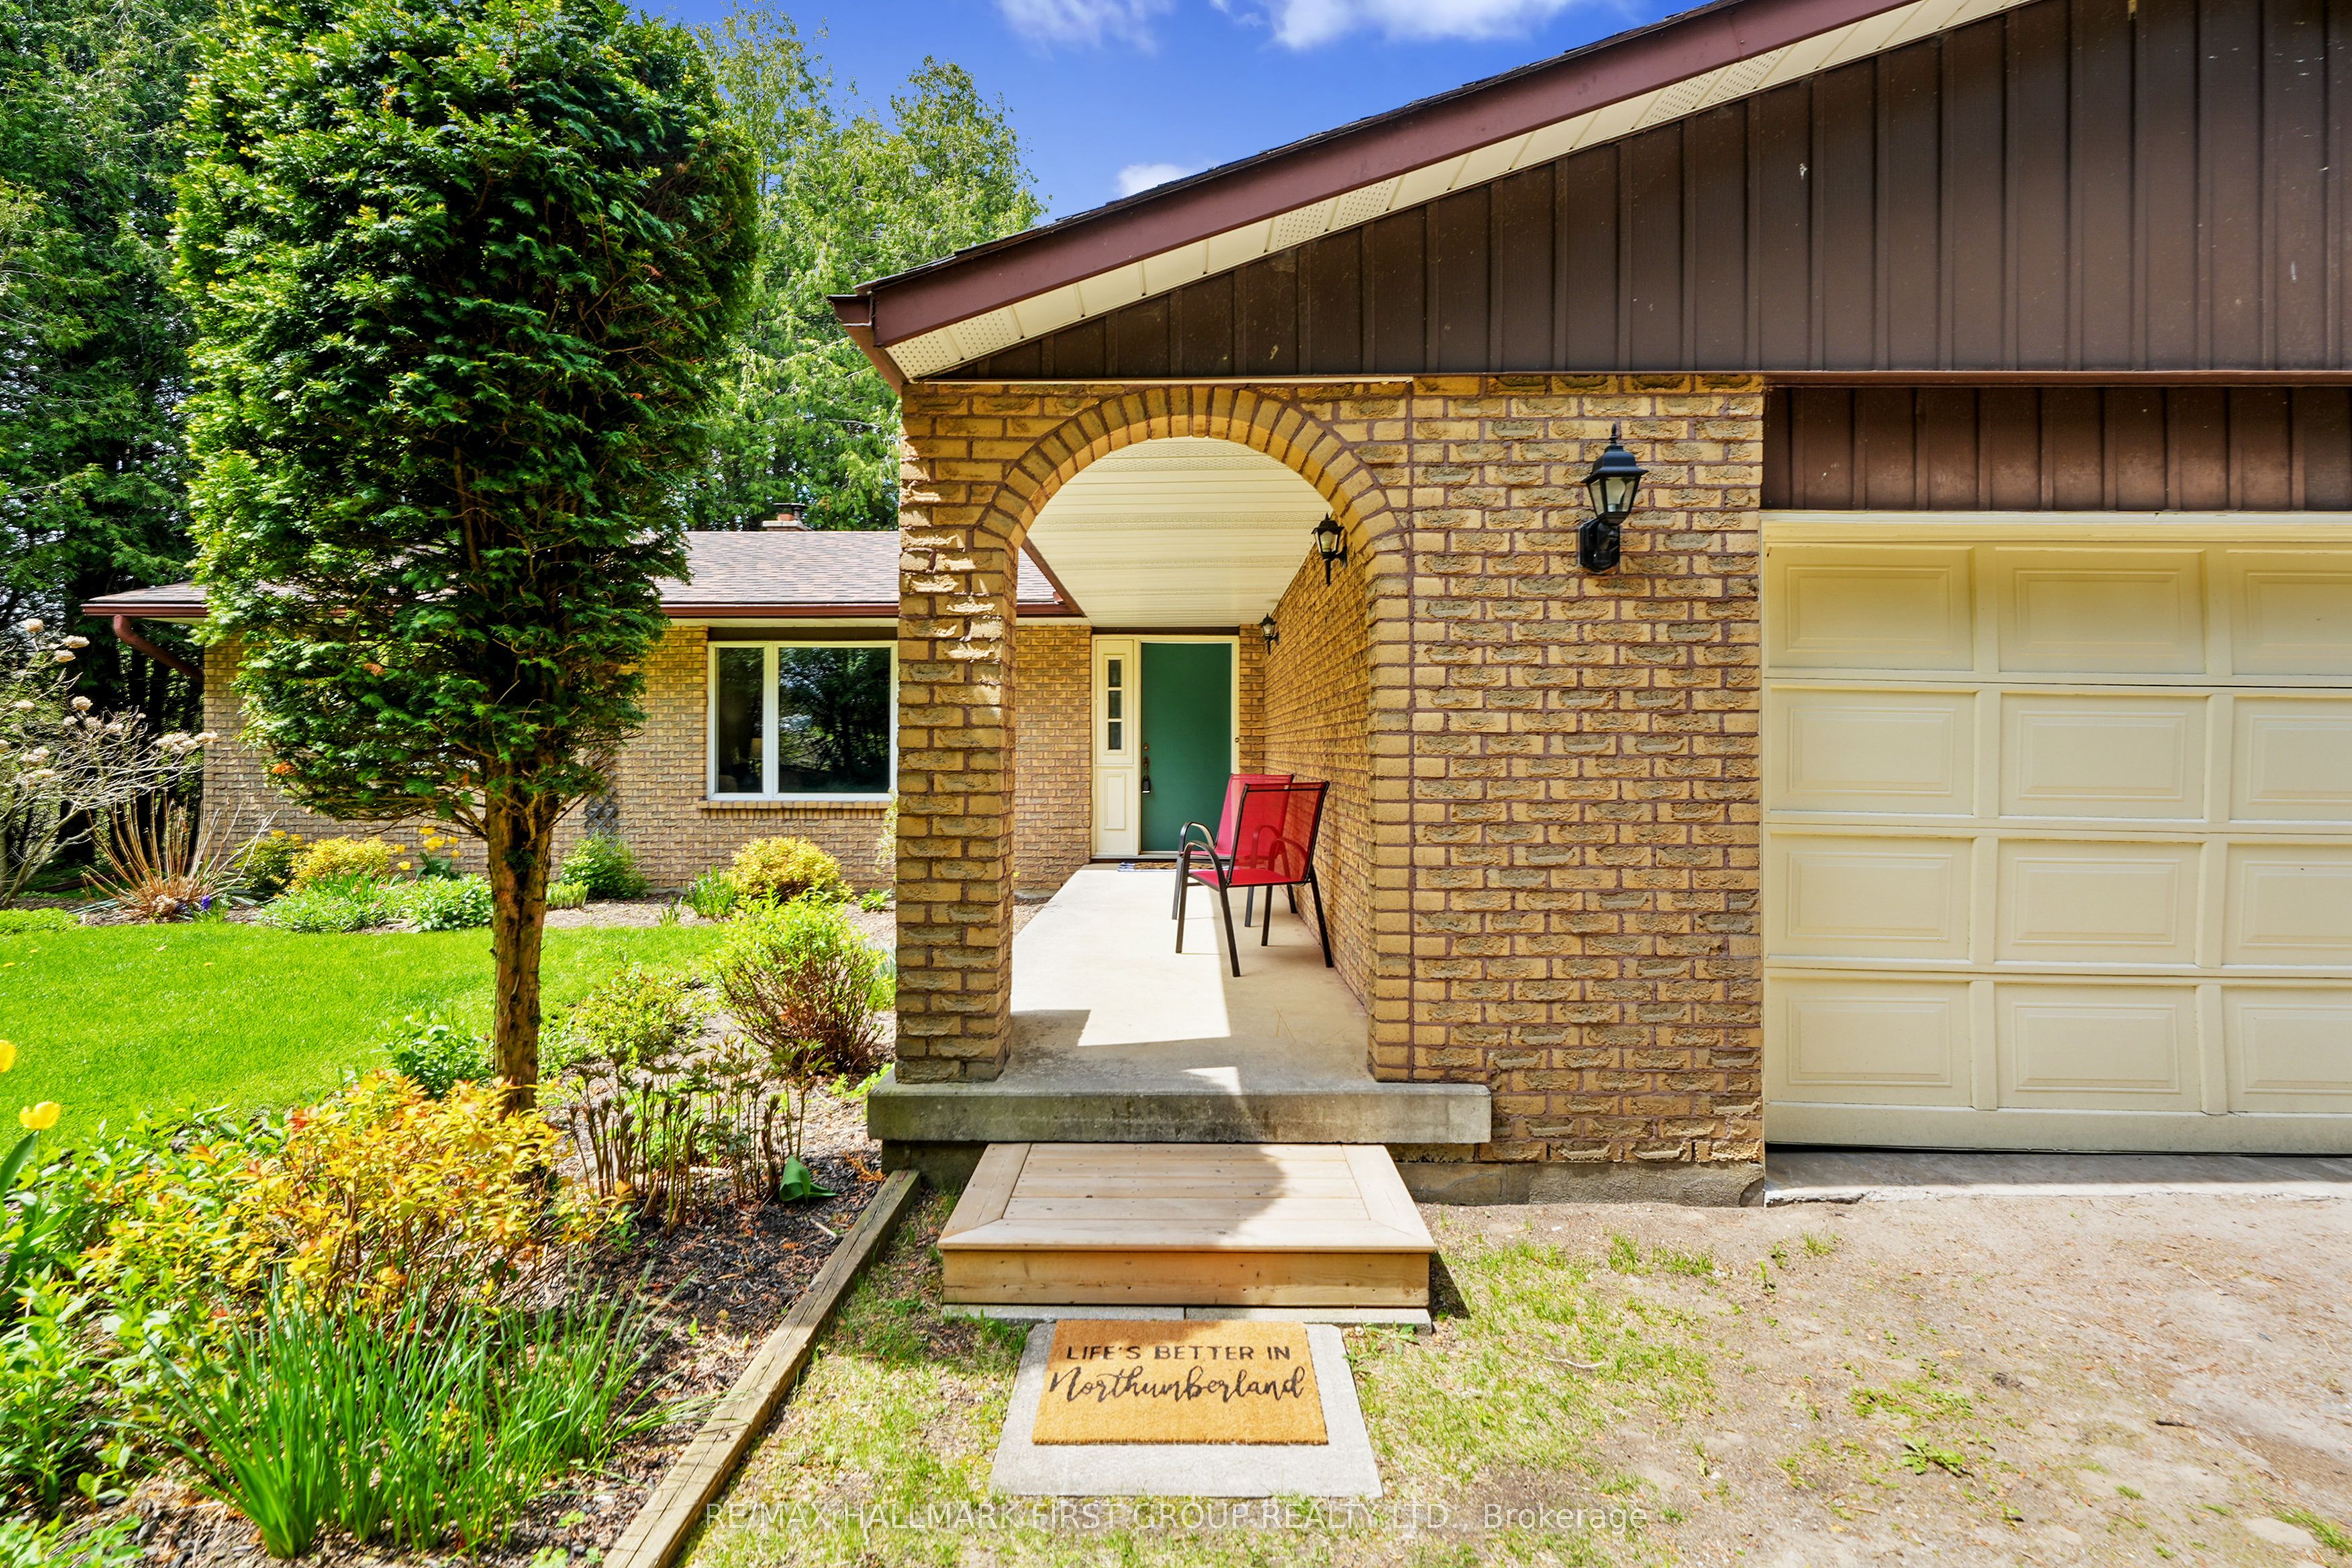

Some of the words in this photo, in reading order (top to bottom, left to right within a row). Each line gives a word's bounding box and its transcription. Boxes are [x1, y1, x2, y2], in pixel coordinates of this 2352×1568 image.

[1066, 1345, 1142, 1361] LIFE'S
[1153, 1345, 1255, 1361] BETTER
[1267, 1346, 1291, 1361] IN
[1048, 1365, 1306, 1404] Northumberland
